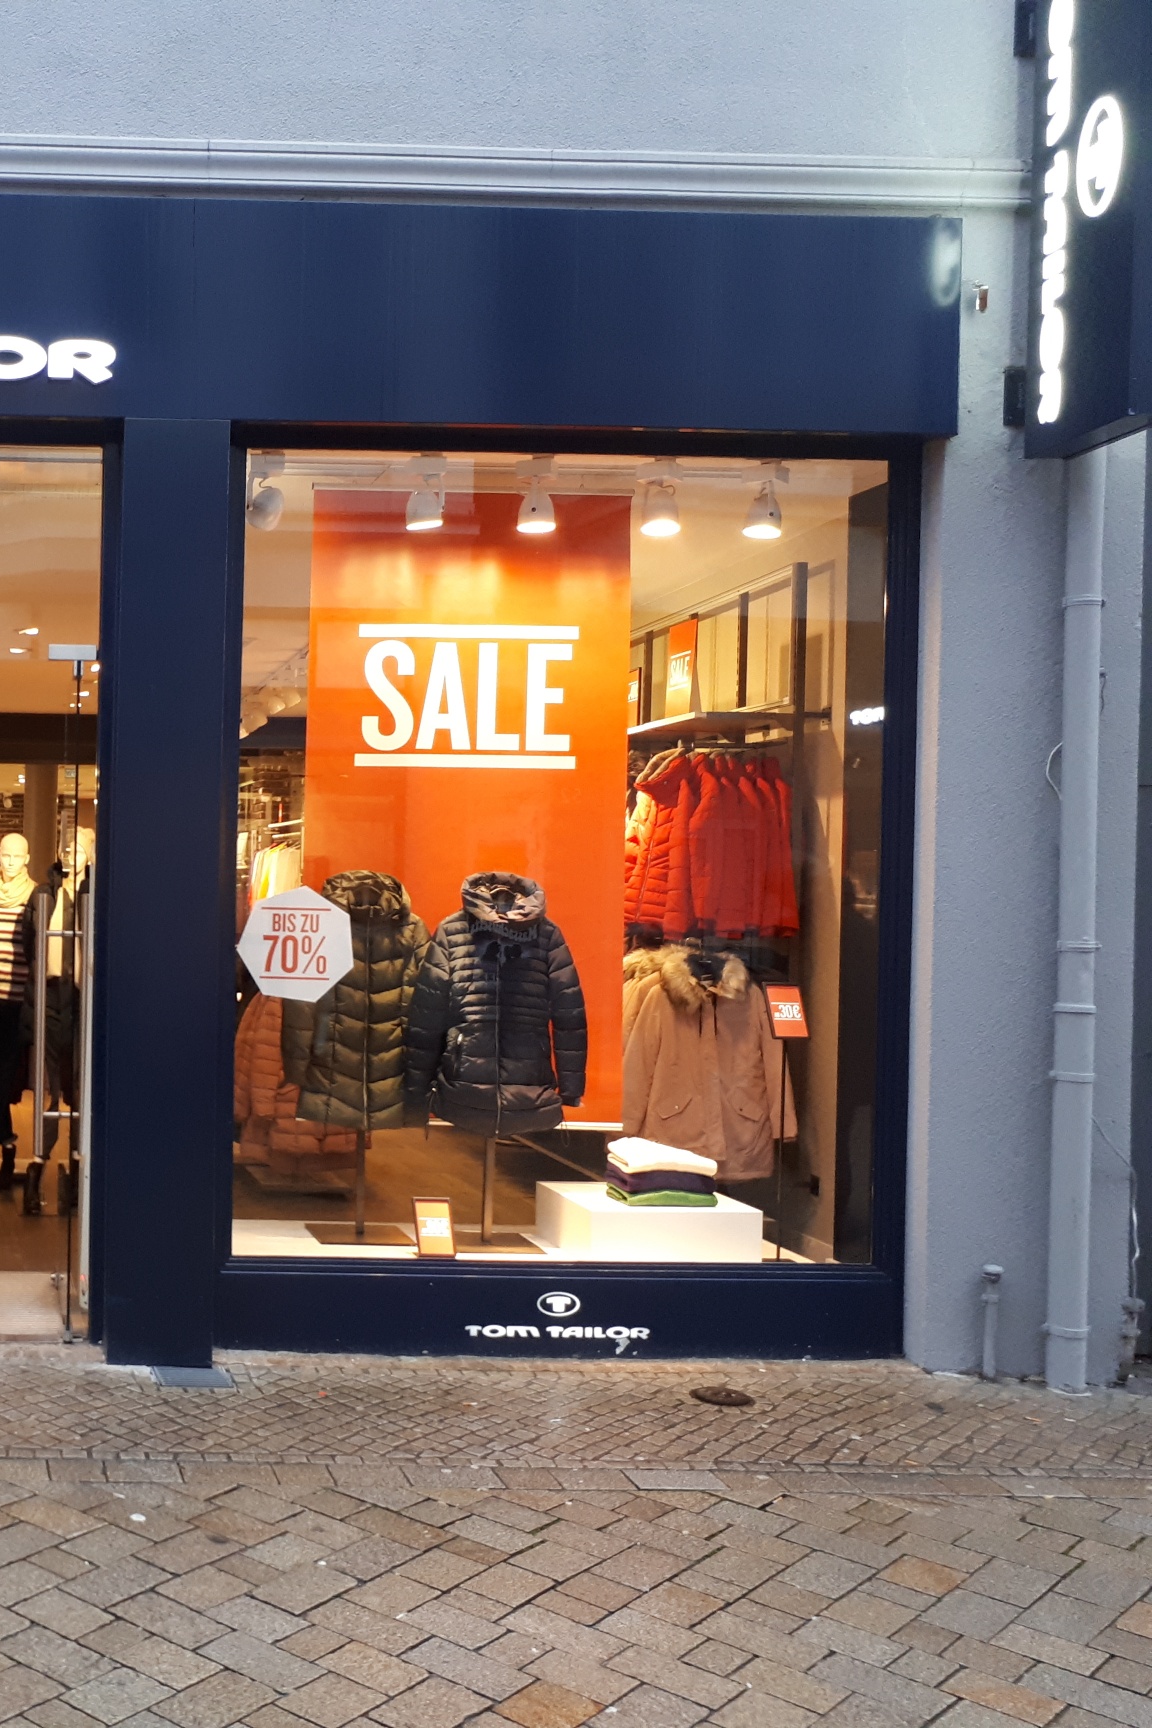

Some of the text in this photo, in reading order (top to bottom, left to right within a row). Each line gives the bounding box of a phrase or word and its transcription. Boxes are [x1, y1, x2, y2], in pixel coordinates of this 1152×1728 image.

[1037, 150, 1069, 424] TAILOR
[669, 655, 691, 687] SALE
[361, 640, 573, 752] SALE
[272, 913, 319, 933] BIS ZU
[262, 934, 327, 975] 70%
[465, 1325, 651, 1339] TOM TAILOR
